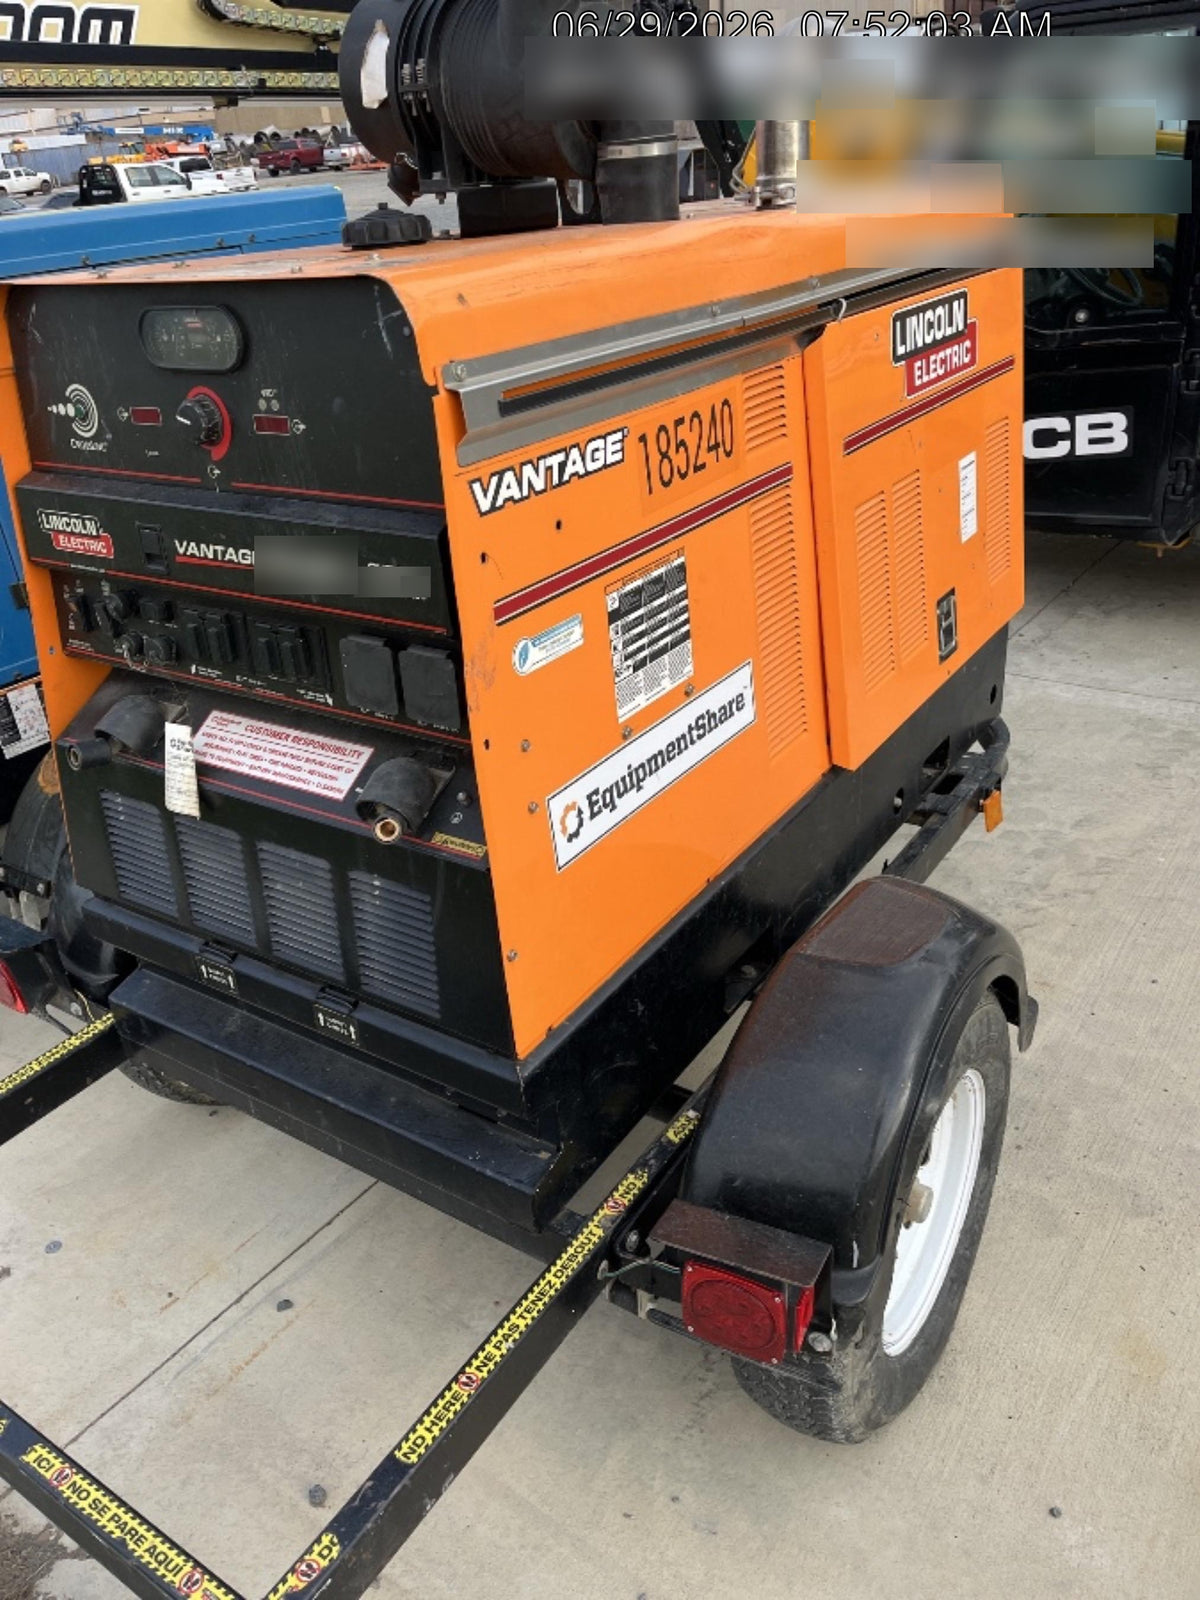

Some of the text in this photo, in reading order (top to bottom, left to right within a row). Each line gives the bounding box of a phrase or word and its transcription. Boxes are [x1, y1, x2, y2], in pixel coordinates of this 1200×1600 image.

[895, 298, 966, 356] LINCOLN
[913, 340, 972, 387] ELECTRIC
[638, 398, 734, 495] 185240
[1023, 412, 1129, 460] CB
[471, 428, 625, 516] VANTAGE
[41, 512, 98, 536] LINCOLN
[58, 535, 107, 554] ELECTRIC
[174, 538, 255, 565] VANTAG
[245, 724, 291, 742] CUSTOMER
[291, 735, 366, 760] RESPONSIBILITY
[586, 693, 746, 821] EquipmentShare
[474, 1228, 598, 1373] NE PAS TENEZ DEBOUT
[401, 1389, 464, 1461] ND HERE
[33, 1453, 55, 1474] ICI
[66, 1479, 187, 1579] NO SE PARE AQUÍ
